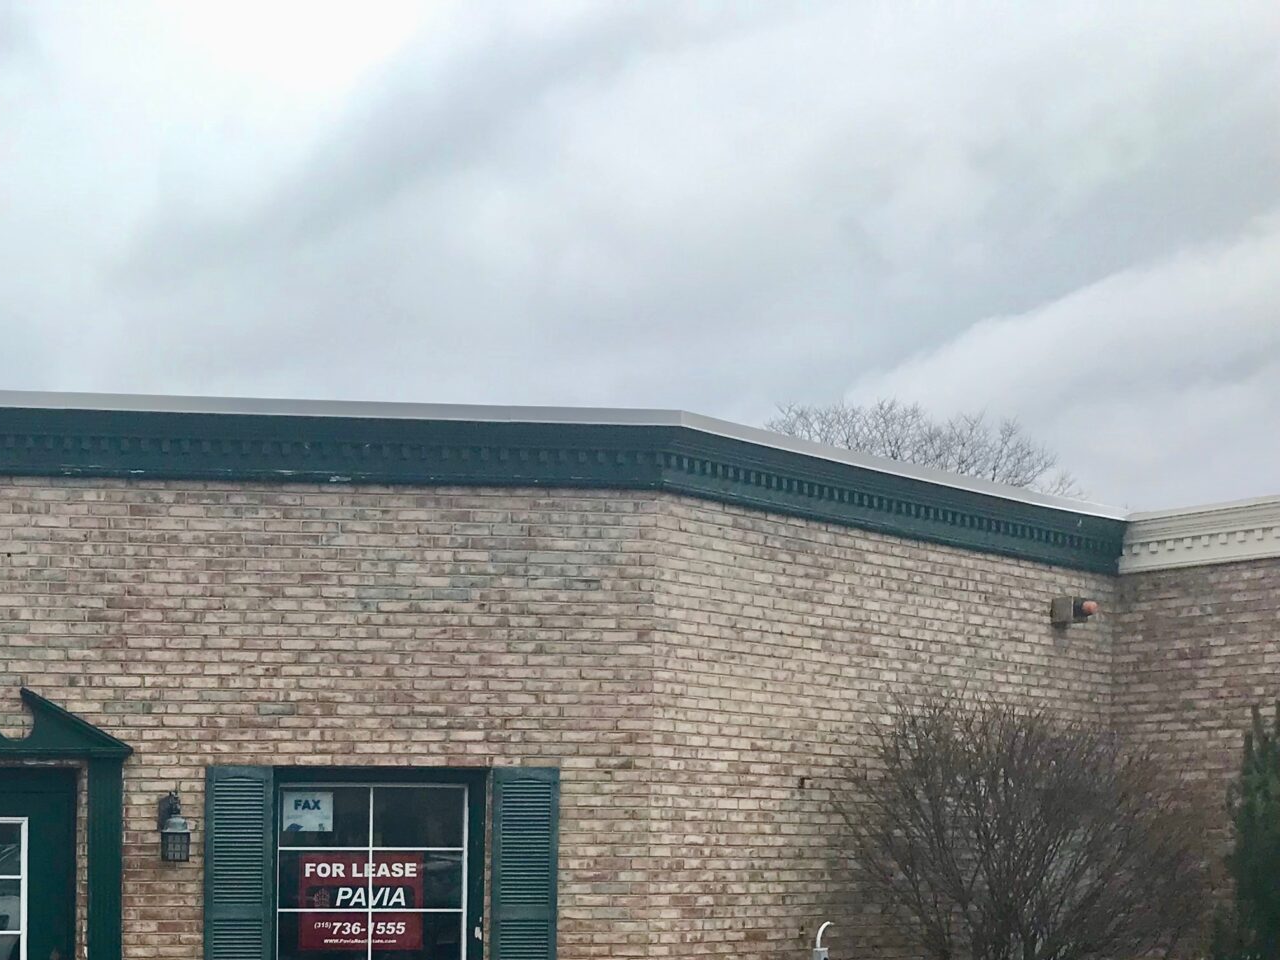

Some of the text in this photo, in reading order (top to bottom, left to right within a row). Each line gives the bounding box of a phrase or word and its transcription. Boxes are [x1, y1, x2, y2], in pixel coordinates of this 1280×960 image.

[294, 799, 321, 810] FAX
[305, 863, 417, 877] FOR LEASE
[335, 887, 406, 906] PAVIA
[314, 922, 406, 935] (315) 736-1555
